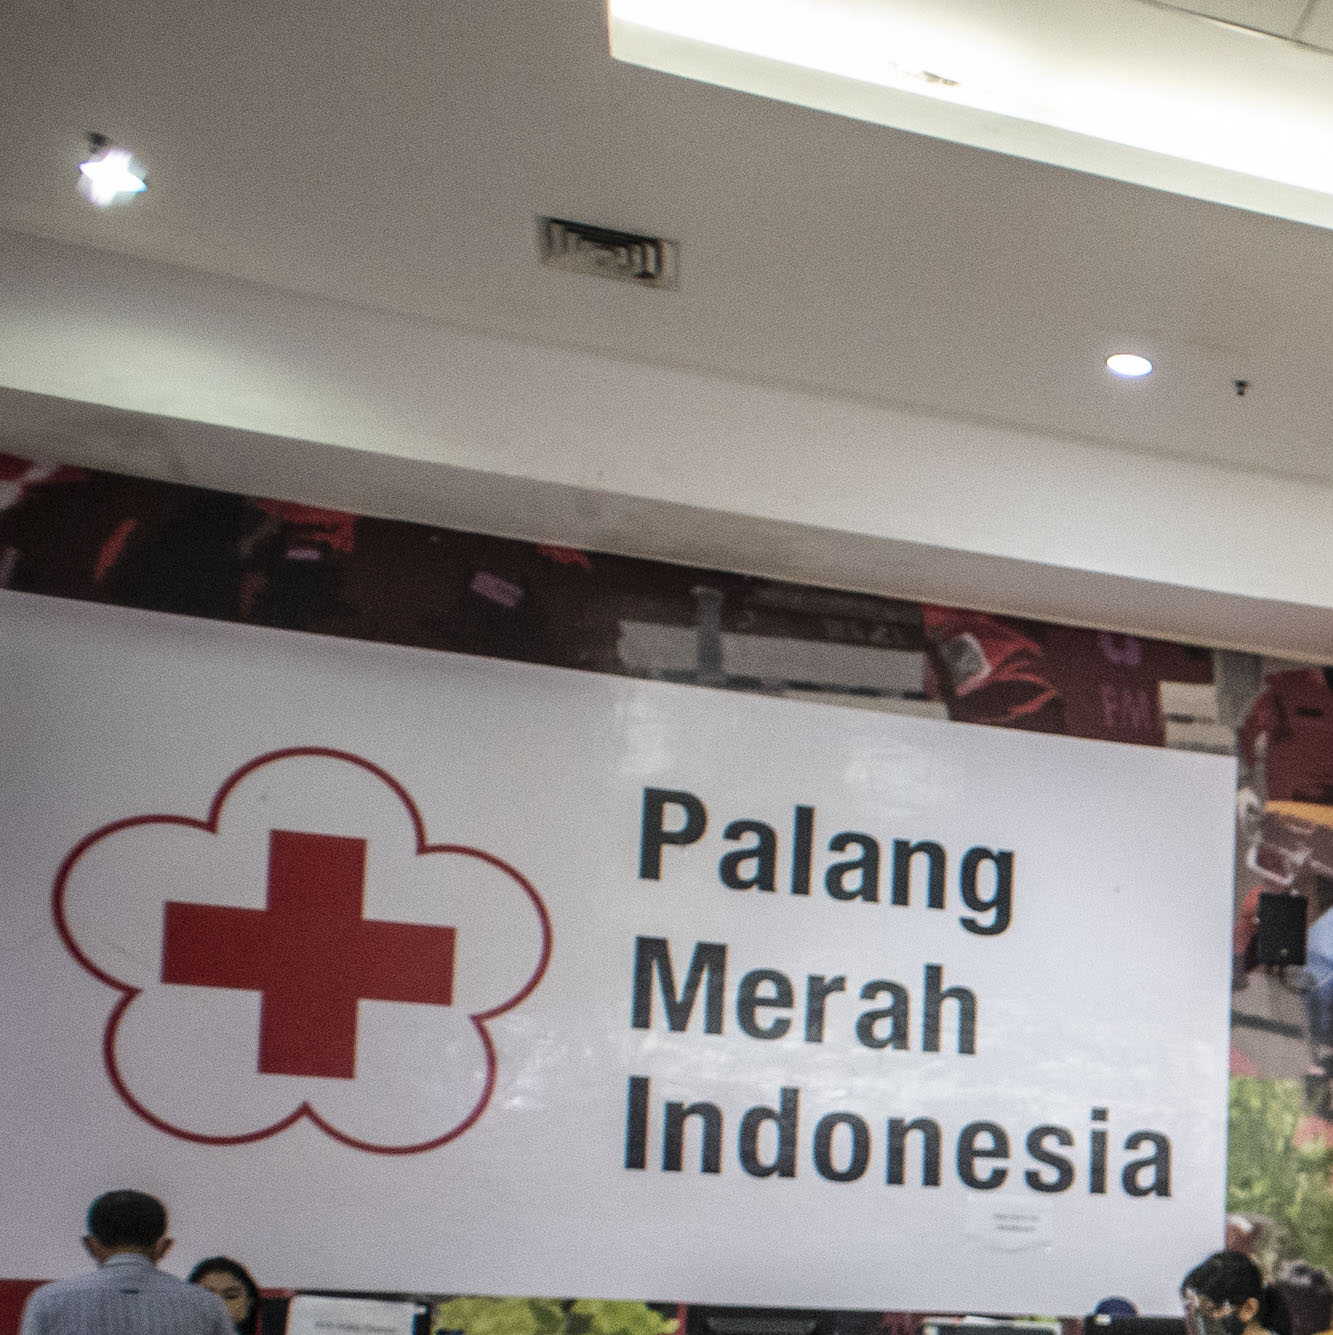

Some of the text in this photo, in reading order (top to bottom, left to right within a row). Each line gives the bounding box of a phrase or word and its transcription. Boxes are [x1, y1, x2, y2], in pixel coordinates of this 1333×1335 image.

[637, 786, 1015, 937] Palang
[630, 934, 978, 1056] Merah
[623, 1075, 1174, 1199] Indonesia
